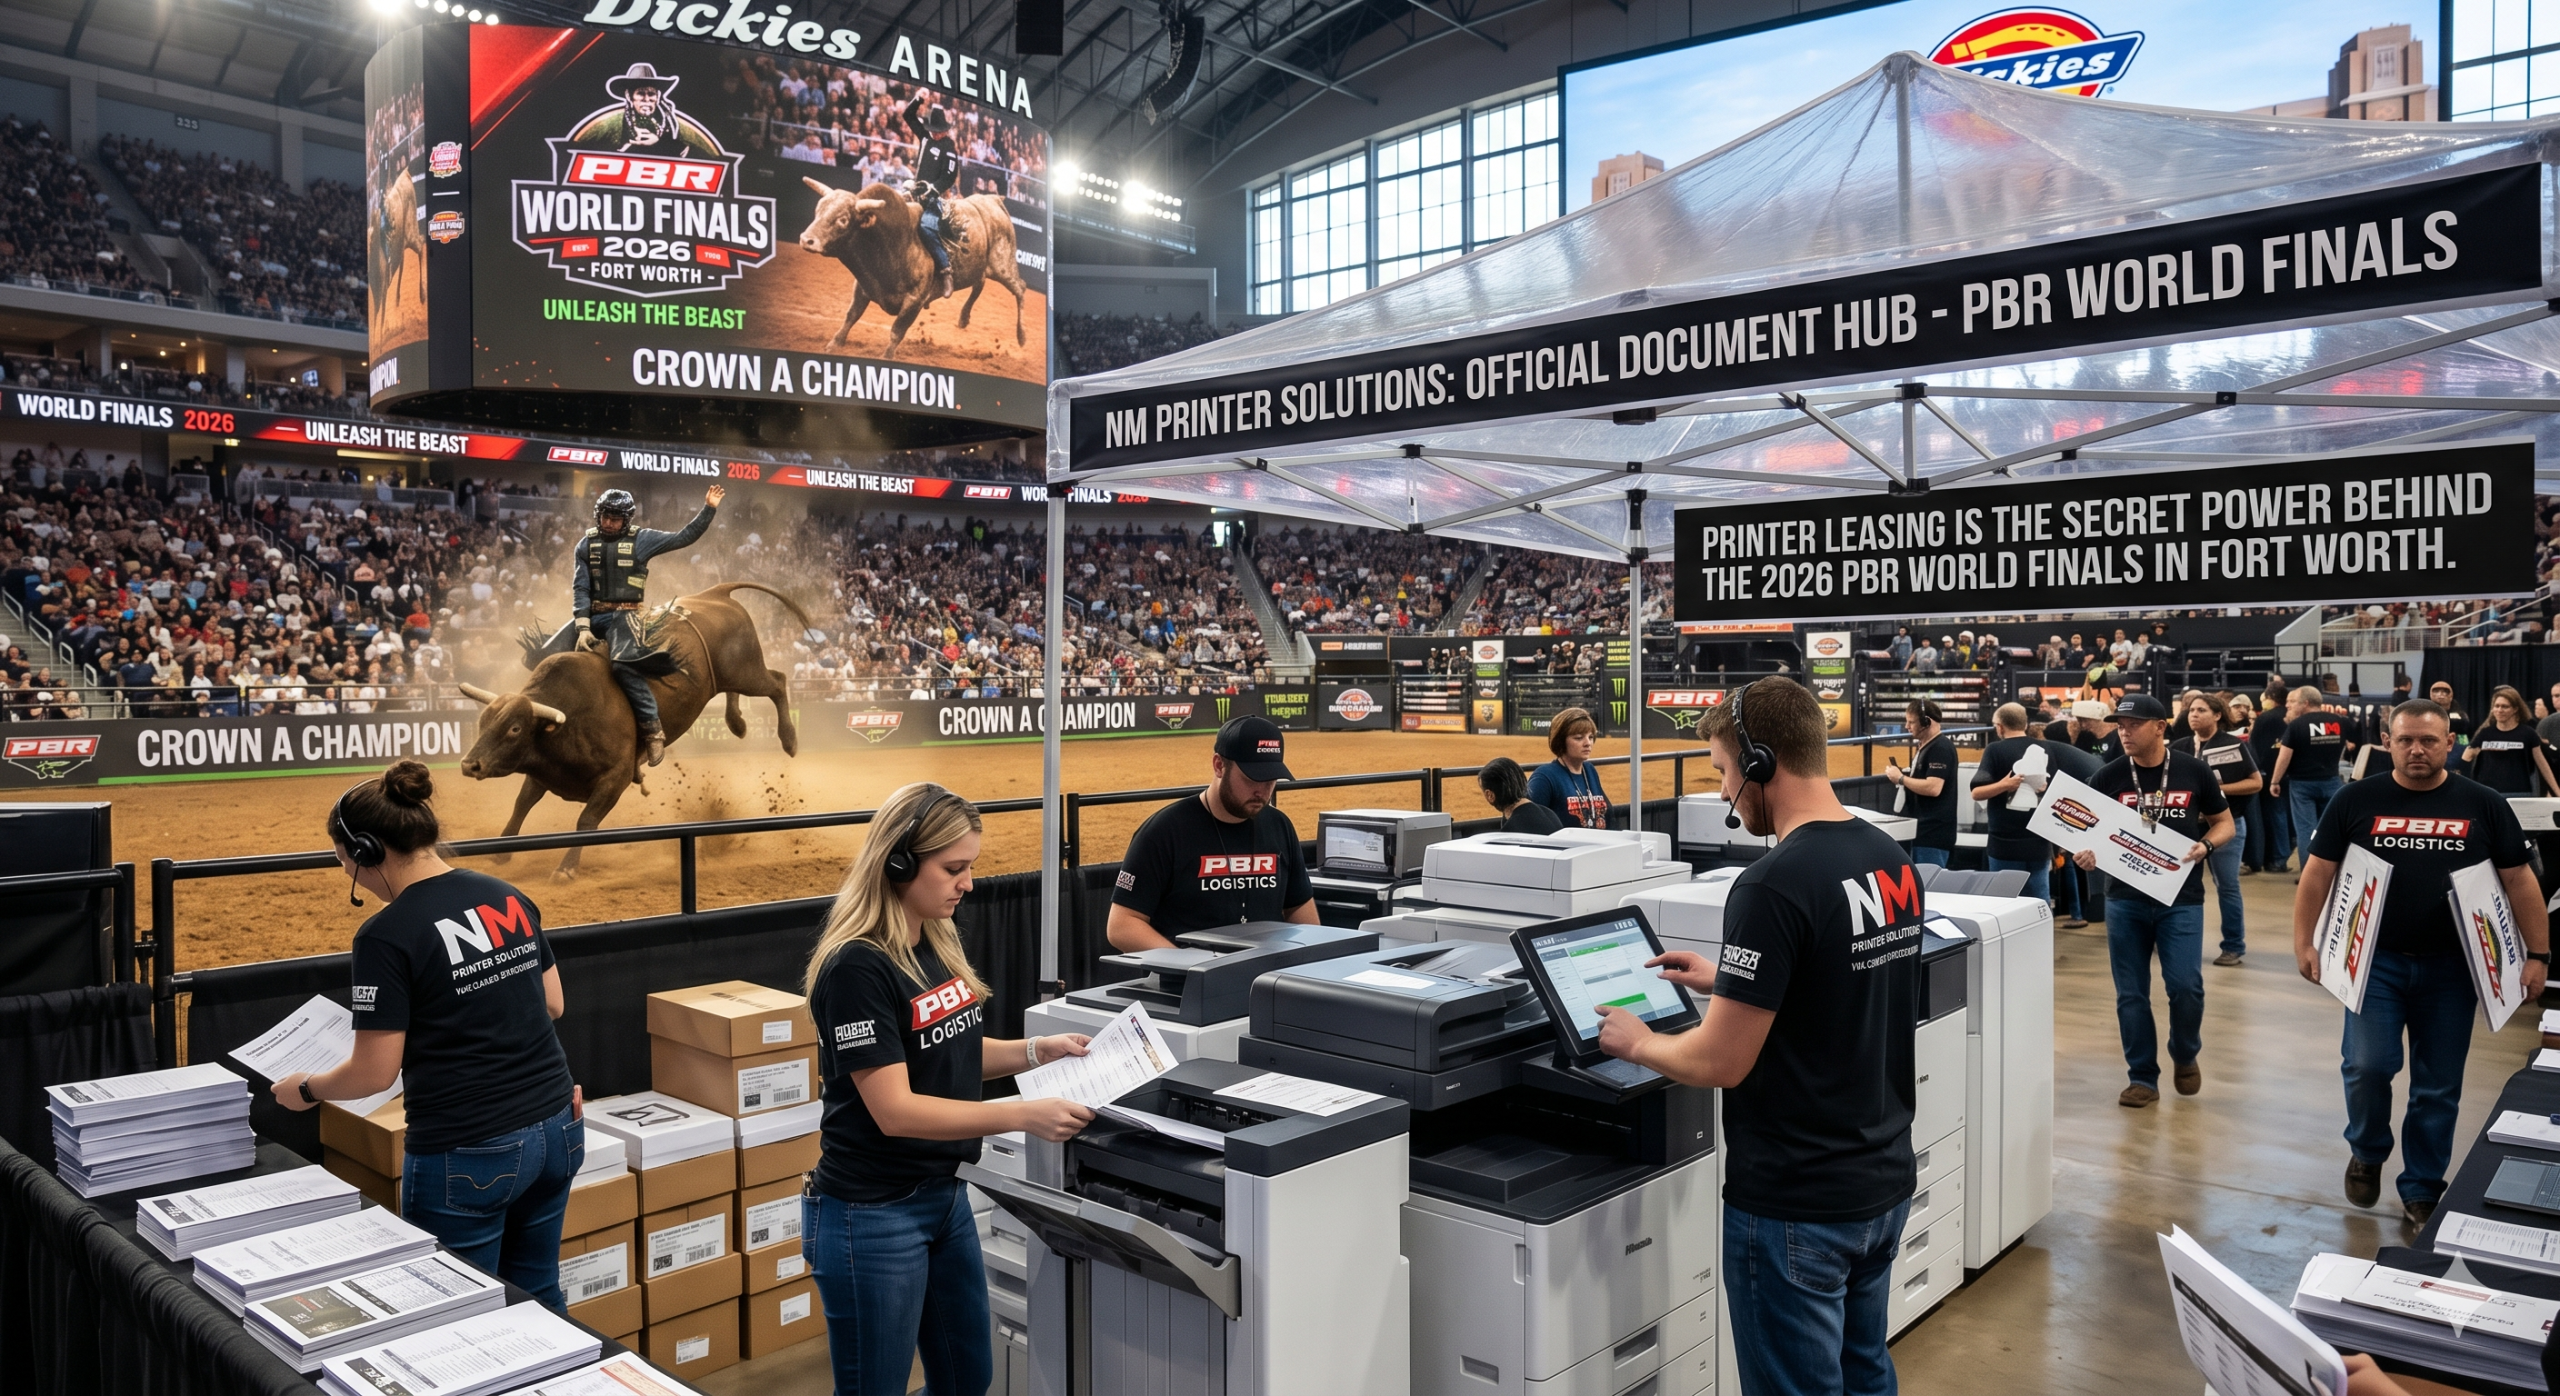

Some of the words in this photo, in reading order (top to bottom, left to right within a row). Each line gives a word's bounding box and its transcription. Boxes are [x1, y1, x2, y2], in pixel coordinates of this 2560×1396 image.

[583, 0, 861, 60] Dickies
[888, 35, 1034, 119] ARENA
[1972, 51, 2116, 86] ckies
[578, 156, 716, 190] PBR
[520, 189, 645, 234] WORLD
[653, 197, 769, 249] FINALS
[603, 236, 691, 262] 2026
[590, 262, 635, 280] FORT
[640, 265, 702, 284] WORTH
[543, 298, 637, 324] UNLEASH
[642, 303, 680, 327] THE
[685, 306, 747, 330] BEAST
[1105, 406, 1147, 449] NM
[1156, 389, 1272, 442] PRINTER
[1281, 362, 1455, 426] SOLUTIONS:
[1466, 340, 1609, 400] OFFICIAL
[1618, 306, 1822, 380] DOCUMENT
[1833, 293, 1917, 351] HUB
[1962, 272, 2053, 334] PBR
[2066, 242, 2245, 320] WORLD
[2262, 209, 2458, 294] FINALS
[632, 347, 761, 391] CROWN
[770, 356, 794, 394] A
[16, 393, 96, 421] WORLD
[100, 401, 174, 428] FINALS
[183, 409, 235, 433] 2026
[305, 421, 382, 447] UNLEASH
[384, 428, 416, 450] THE
[419, 432, 469, 454] BEAST
[551, 448, 604, 464] PBR
[620, 451, 671, 472] WORLD
[672, 455, 721, 477] FINALS
[727, 462, 761, 480] 2026
[806, 469, 857, 489] UNLEASH
[858, 474, 880, 491] THE
[881, 476, 915, 494] BEAST
[1021, 485, 1048, 502] WOR
[1067, 486, 1112, 503] FINALS
[1702, 518, 1816, 561] PRINTER
[1825, 510, 1946, 553] LEASING
[1955, 507, 1983, 546] IS
[1991, 502, 2053, 543] THE
[2062, 492, 2191, 540] SECRET
[2201, 483, 2331, 532] POWER
[2344, 471, 2493, 523] BEHIND
[1702, 565, 1753, 601] THE
[1761, 561, 1833, 599] 2026
[1842, 558, 1900, 596] PBR
[1907, 550, 2018, 593] WORLD
[2028, 543, 2144, 588] FINALS
[2155, 541, 2189, 582] IN
[2200, 535, 2292, 580] FORT
[2302, 526, 2457, 576] WORTH.
[1651, 691, 1719, 705] PBR
[852, 713, 900, 726] PBR
[939, 705, 1014, 736] CROWN
[1019, 704, 1033, 732] A
[1037, 702, 1136, 733] CAMPION
[2308, 721, 2341, 737] NM
[9, 737, 96, 756] PBR
[137, 727, 263, 768] CROWN
[272, 727, 294, 762] A
[302, 721, 461, 761] CHAMPION
[2376, 817, 2465, 836] PBR
[2373, 836, 2466, 852] LOGISTICS
[1203, 855, 1274, 874] PBR
[1201, 876, 1277, 891] LOGISTICS
[1841, 864, 1921, 936] NM
[433, 895, 534, 966] NM
[452, 957, 494, 980] PRINTER
[920, 1005, 983, 1050] LOGISTIC
